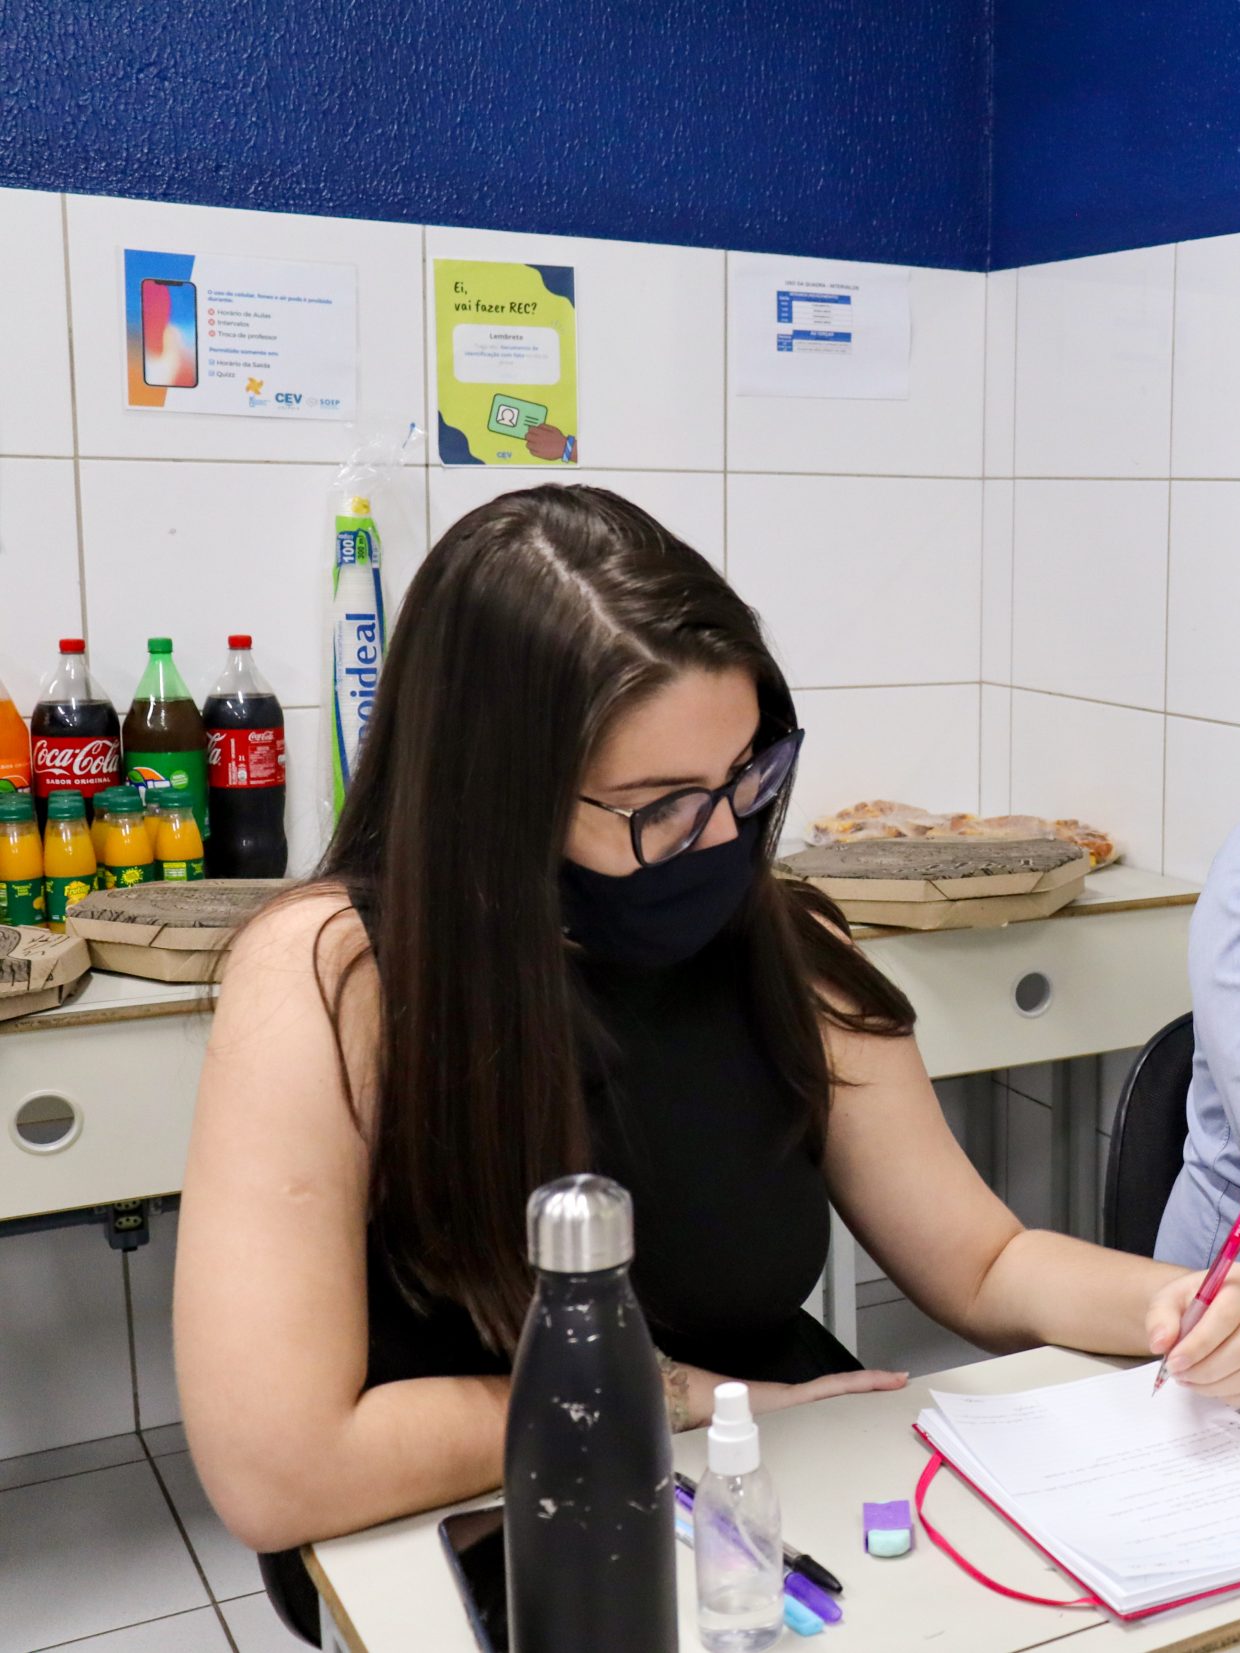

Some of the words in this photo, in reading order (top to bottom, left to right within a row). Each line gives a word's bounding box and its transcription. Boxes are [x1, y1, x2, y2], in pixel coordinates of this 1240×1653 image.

[454, 281, 468, 294] Ei,
[217, 309, 242, 317] Horário
[454, 300, 472, 312] vai
[476, 300, 505, 314] fazer
[510, 301, 538, 314] REC?
[218, 320, 250, 328] Intervalos
[490, 333, 524, 341] Lembrete
[274, 392, 302, 404] CEV
[342, 540, 355, 562] 100
[34, 740, 120, 776] Coca-Cola
